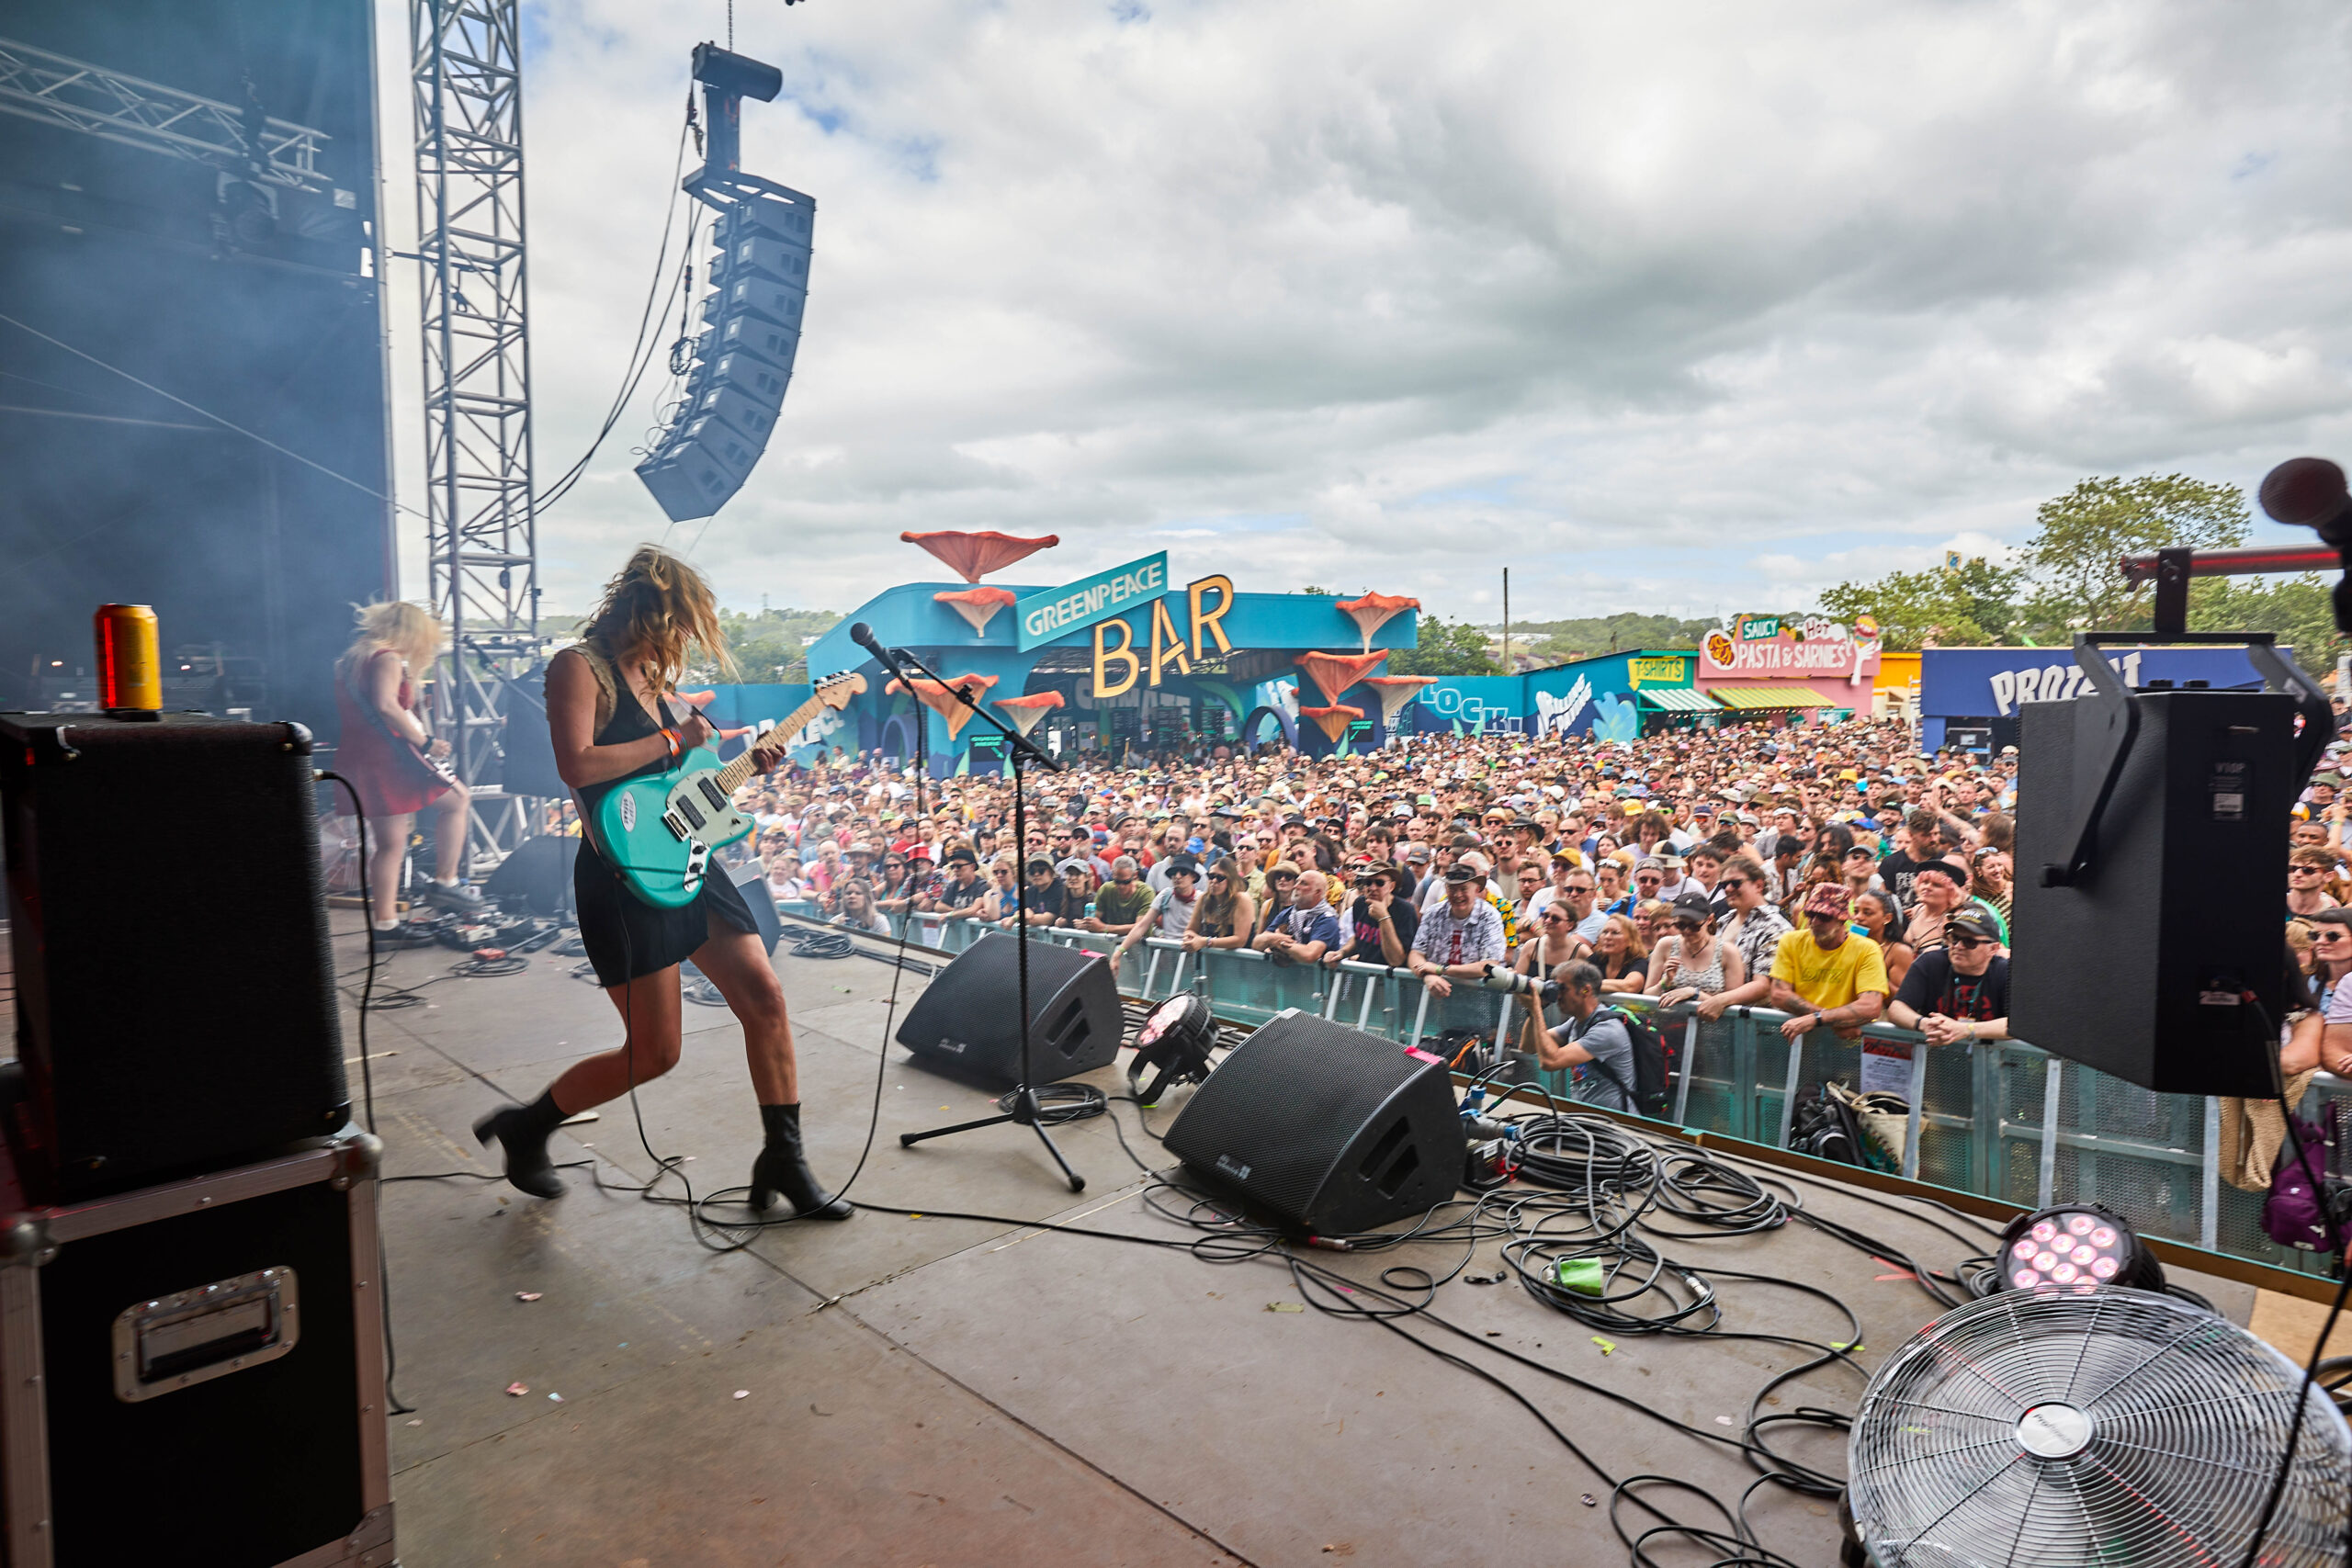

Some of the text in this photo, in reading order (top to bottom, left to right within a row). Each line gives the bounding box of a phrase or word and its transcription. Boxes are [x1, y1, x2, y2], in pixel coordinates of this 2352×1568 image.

[1025, 561, 1162, 636] GREENPEACE
[1092, 574, 1234, 698] BAR
[1744, 619, 1778, 639] SAUCY
[1635, 660, 1682, 677] T-SHIRTS
[1737, 644, 1781, 669] PASTA
[1781, 646, 1793, 666] &
[1989, 651, 2142, 716] PROTT
